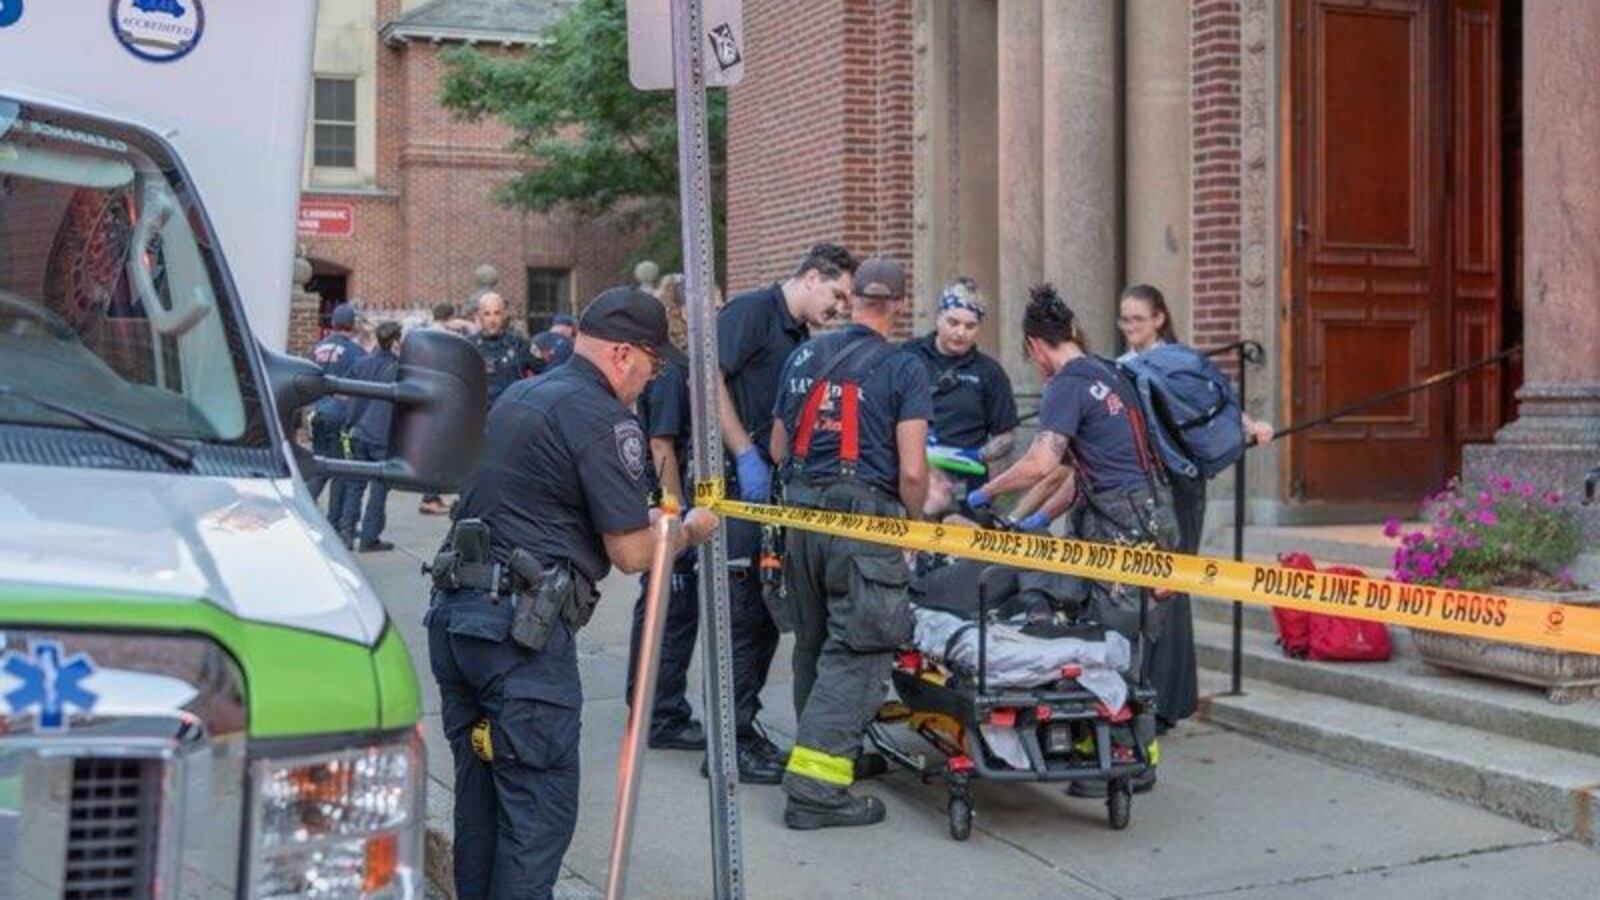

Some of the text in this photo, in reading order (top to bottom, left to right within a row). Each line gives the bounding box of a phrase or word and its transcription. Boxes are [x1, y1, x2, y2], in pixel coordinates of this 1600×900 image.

[122, 16, 193, 36] ACCREDITED
[970, 530, 1175, 578] POLICE LINE DO NOT CROSS
[1251, 567, 1508, 627] POLICE LINE DO NOT CROSS
